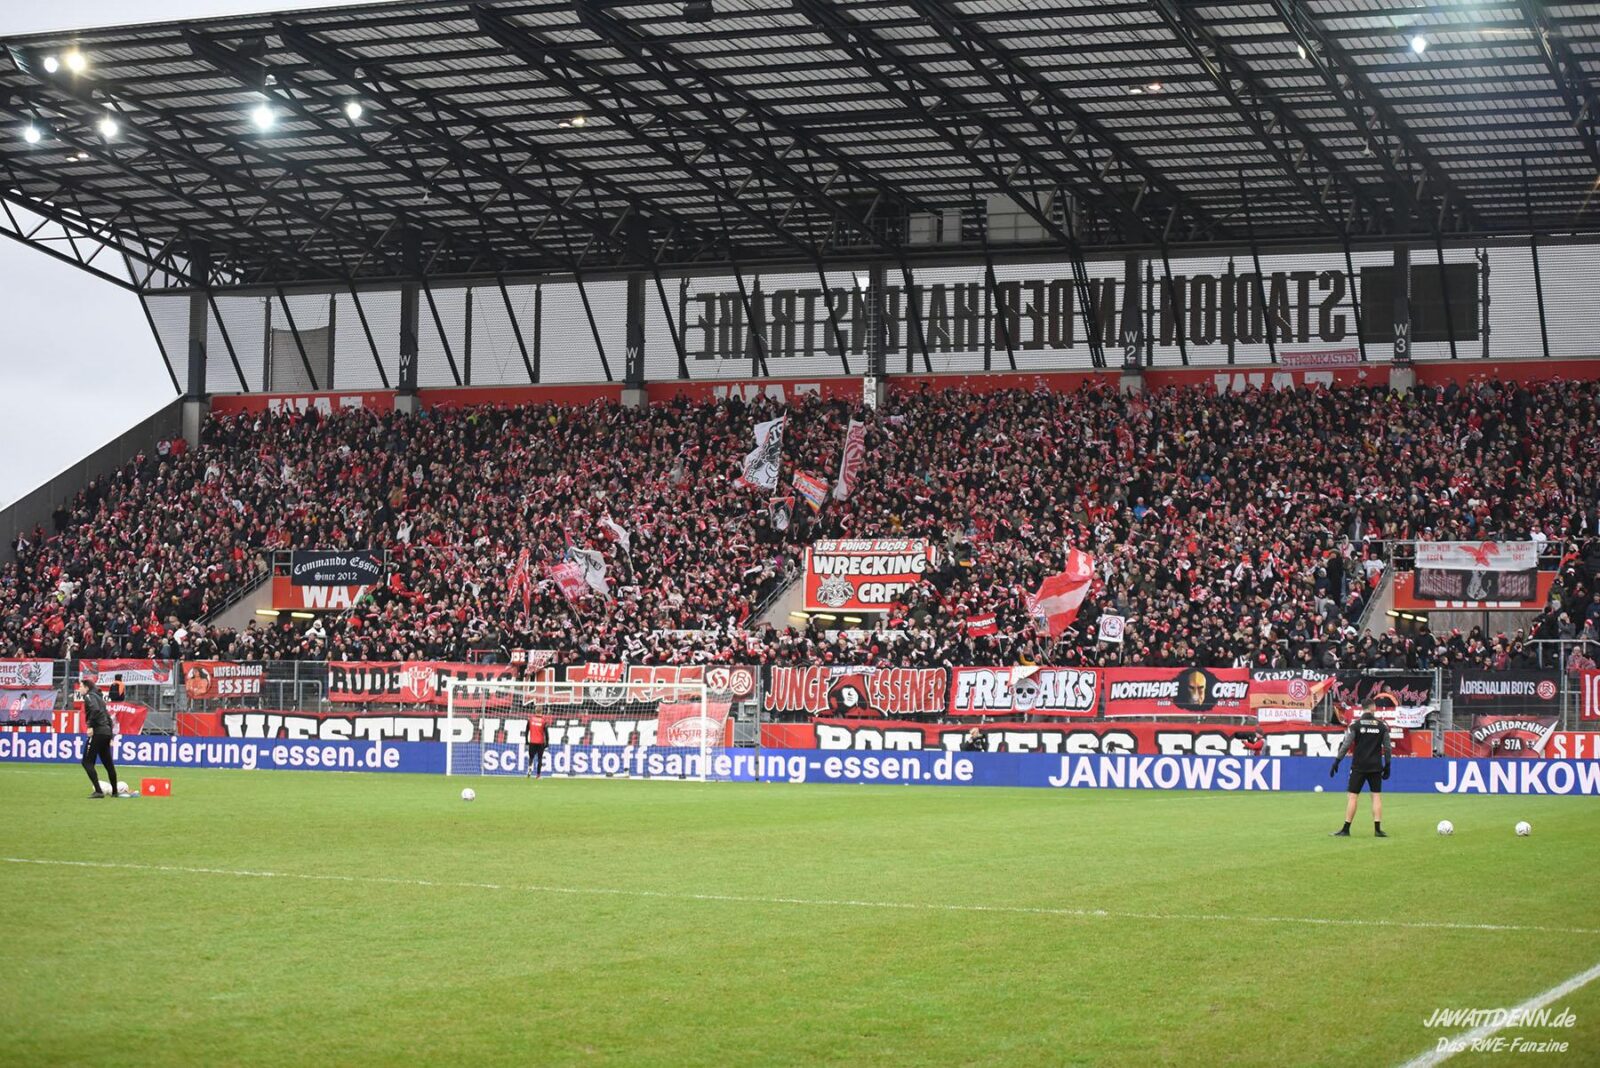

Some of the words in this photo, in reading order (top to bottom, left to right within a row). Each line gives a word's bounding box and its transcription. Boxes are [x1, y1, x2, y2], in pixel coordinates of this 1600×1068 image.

[1394, 323, 1408, 336] W
[1125, 331, 1138, 344] W
[1396, 337, 1406, 353] 3
[626, 347, 638, 359] W
[1126, 345, 1137, 360] 2
[400, 354, 411, 367] W
[402, 368, 408, 381] 1
[629, 362, 635, 375] 1
[817, 540, 837, 551] LOS
[293, 556, 347, 575] Commando
[349, 556, 380, 575] Essen
[812, 553, 926, 575] WRECKING
[314, 572, 336, 581] Since
[337, 572, 358, 581] 2012
[857, 582, 910, 603] CRE
[587, 662, 620, 677] RVT
[1253, 668, 1337, 683] Crazy-Boy
[217, 679, 261, 693] ESSEN
[330, 665, 400, 695] RUDE
[436, 667, 513, 699] FANS
[1460, 673, 1511, 695] ADRENALIN
[1511, 681, 1535, 695] BOYS
[764, 666, 832, 713] JUNGE
[869, 667, 947, 715] ESSENER
[1110, 681, 1179, 700] NORTHSIDE
[1211, 681, 1248, 698] CREW
[1474, 720, 1548, 742] DAUERBRENNE
[1504, 738, 1521, 750] 97A
[0, 731, 400, 770] chadstfsanierung-essen.de
[483, 744, 974, 783] schadstoffsanierung-essen.de
[1048, 755, 1281, 791] JANKOWSKI
